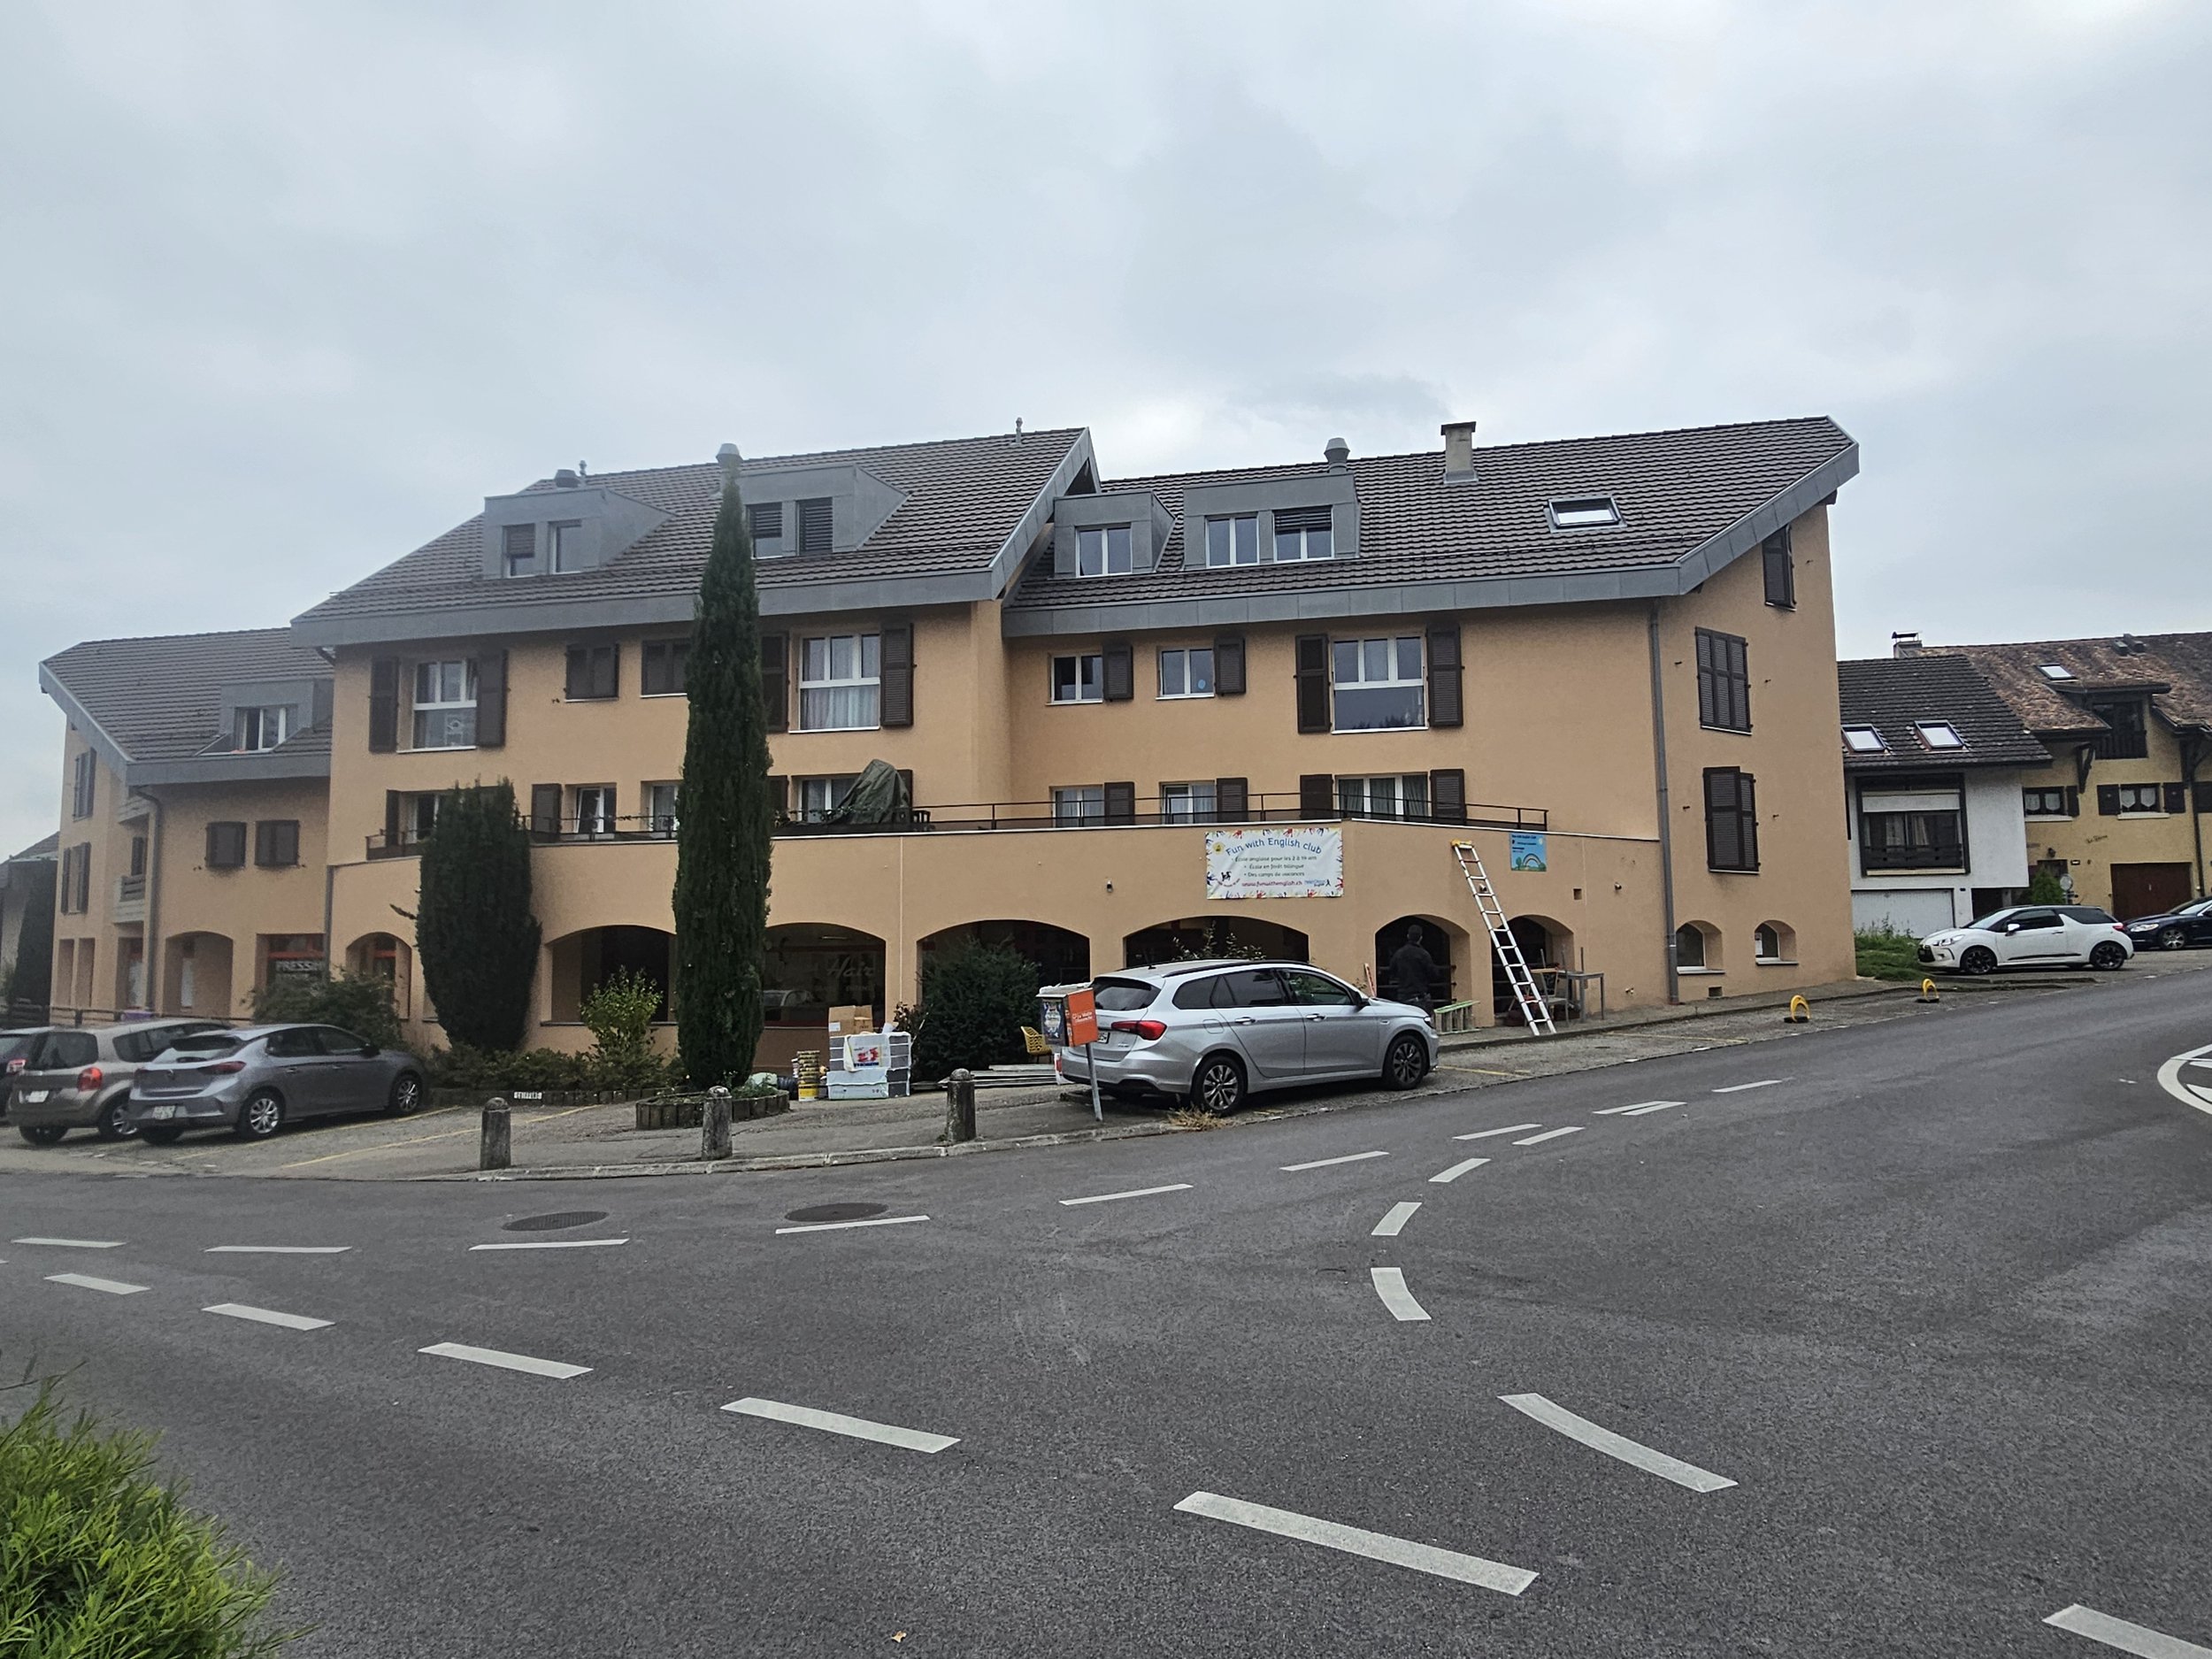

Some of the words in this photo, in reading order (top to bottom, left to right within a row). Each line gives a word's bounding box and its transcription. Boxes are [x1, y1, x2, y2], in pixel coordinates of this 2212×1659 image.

[1225, 845, 1244, 856] Fun
[1245, 838, 1264, 849] with
[1268, 837, 1301, 848] English
[1302, 843, 1322, 855] club
[276, 960, 324, 972] PRESSIN
[826, 956, 875, 979] Hair
